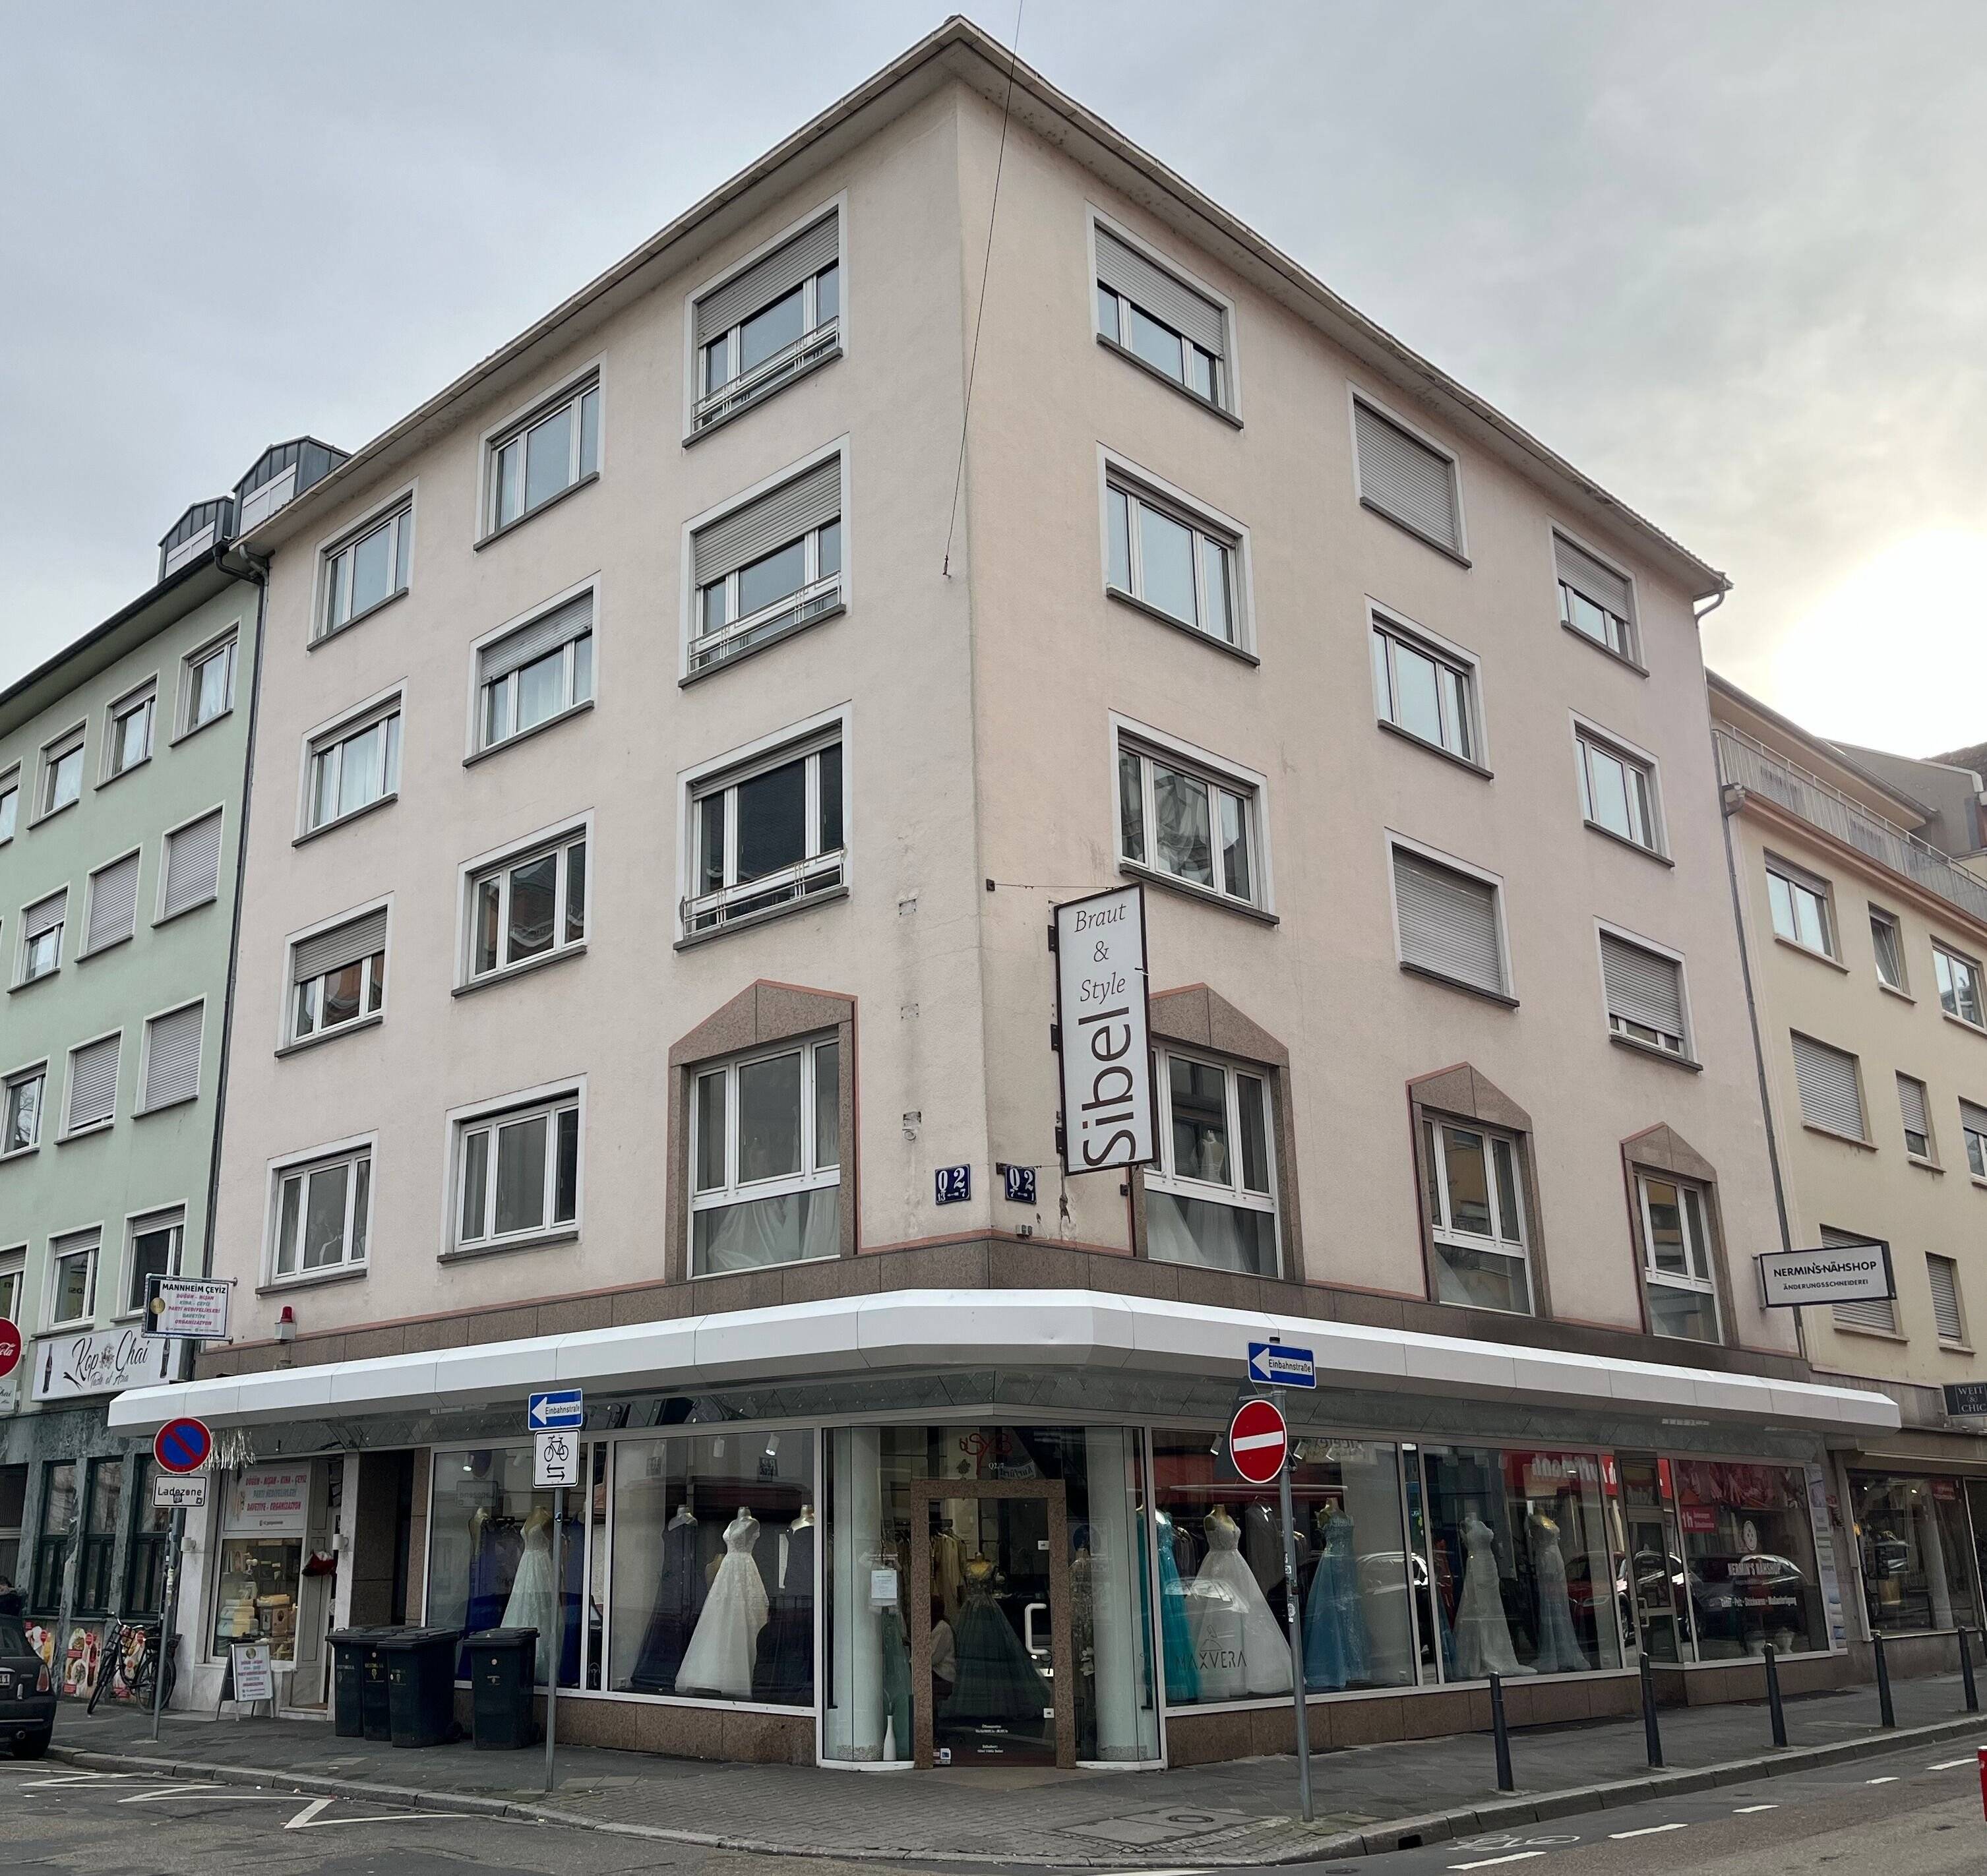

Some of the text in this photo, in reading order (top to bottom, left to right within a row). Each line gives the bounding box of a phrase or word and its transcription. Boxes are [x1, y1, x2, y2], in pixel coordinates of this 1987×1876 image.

[1074, 903, 1127, 933] Braut
[1093, 940, 1110, 963] &
[1080, 971, 1126, 1005] Style
[1078, 1006, 1136, 1166] Sibel
[1783, 1279, 1869, 1291] ÄNDERUNGSSCHNEIDEREI
[115, 1329, 150, 1372] Chai
[1268, 1358, 1311, 1373] Einbahnstraße
[1957, 1385, 1984, 1395] WEIT
[545, 1404, 580, 1415] Einbahnstraße
[158, 1486, 202, 1496] Ladezone
